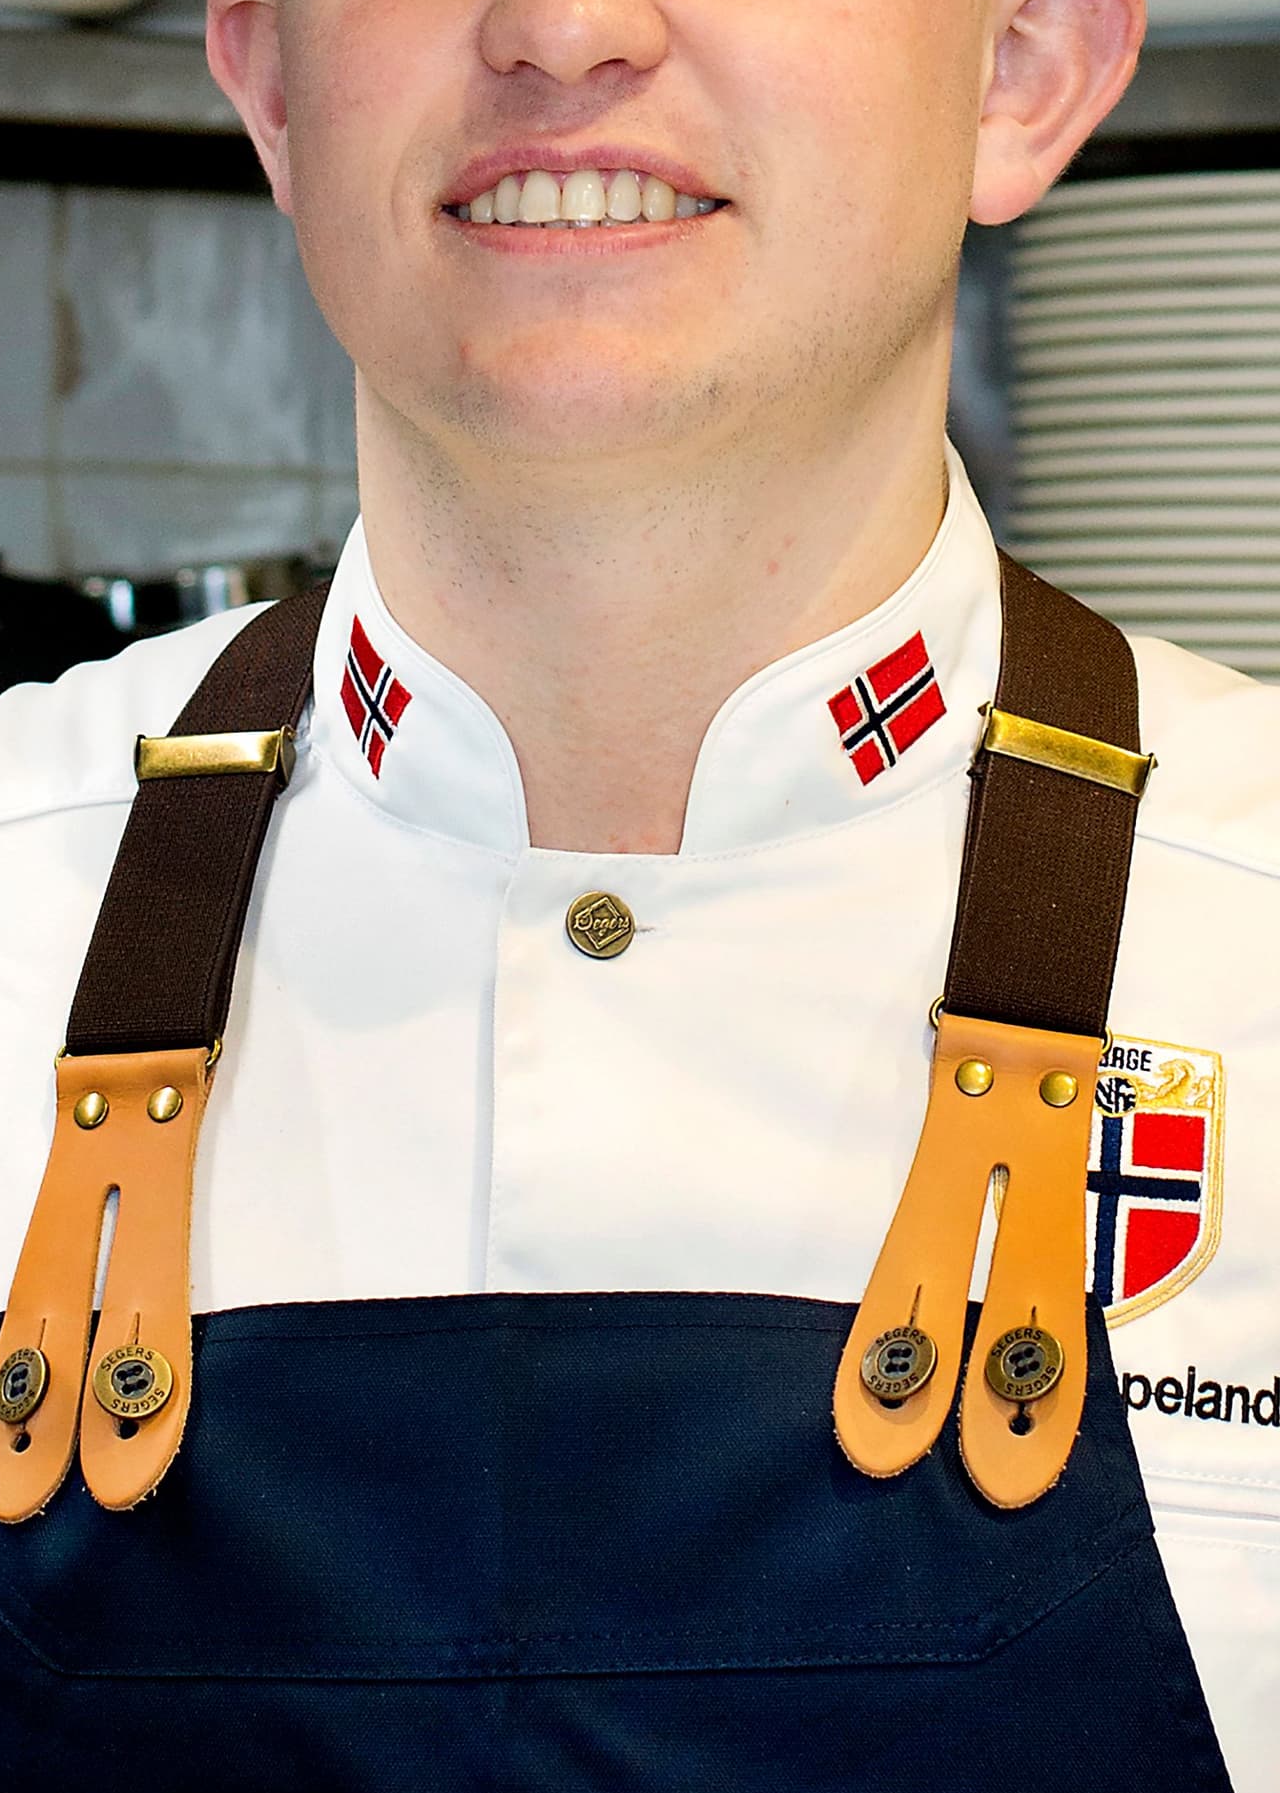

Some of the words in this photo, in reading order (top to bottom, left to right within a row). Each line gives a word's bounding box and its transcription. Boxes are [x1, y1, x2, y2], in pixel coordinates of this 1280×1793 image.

[874, 1327, 927, 1347] SEGERS
[990, 1327, 1044, 1357] SEGERS
[100, 1346, 155, 1372] SEGERS
[868, 1371, 920, 1393] SEGERS
[1004, 1365, 1057, 1397] SEGERS
[111, 1387, 166, 1414] SEGERS
